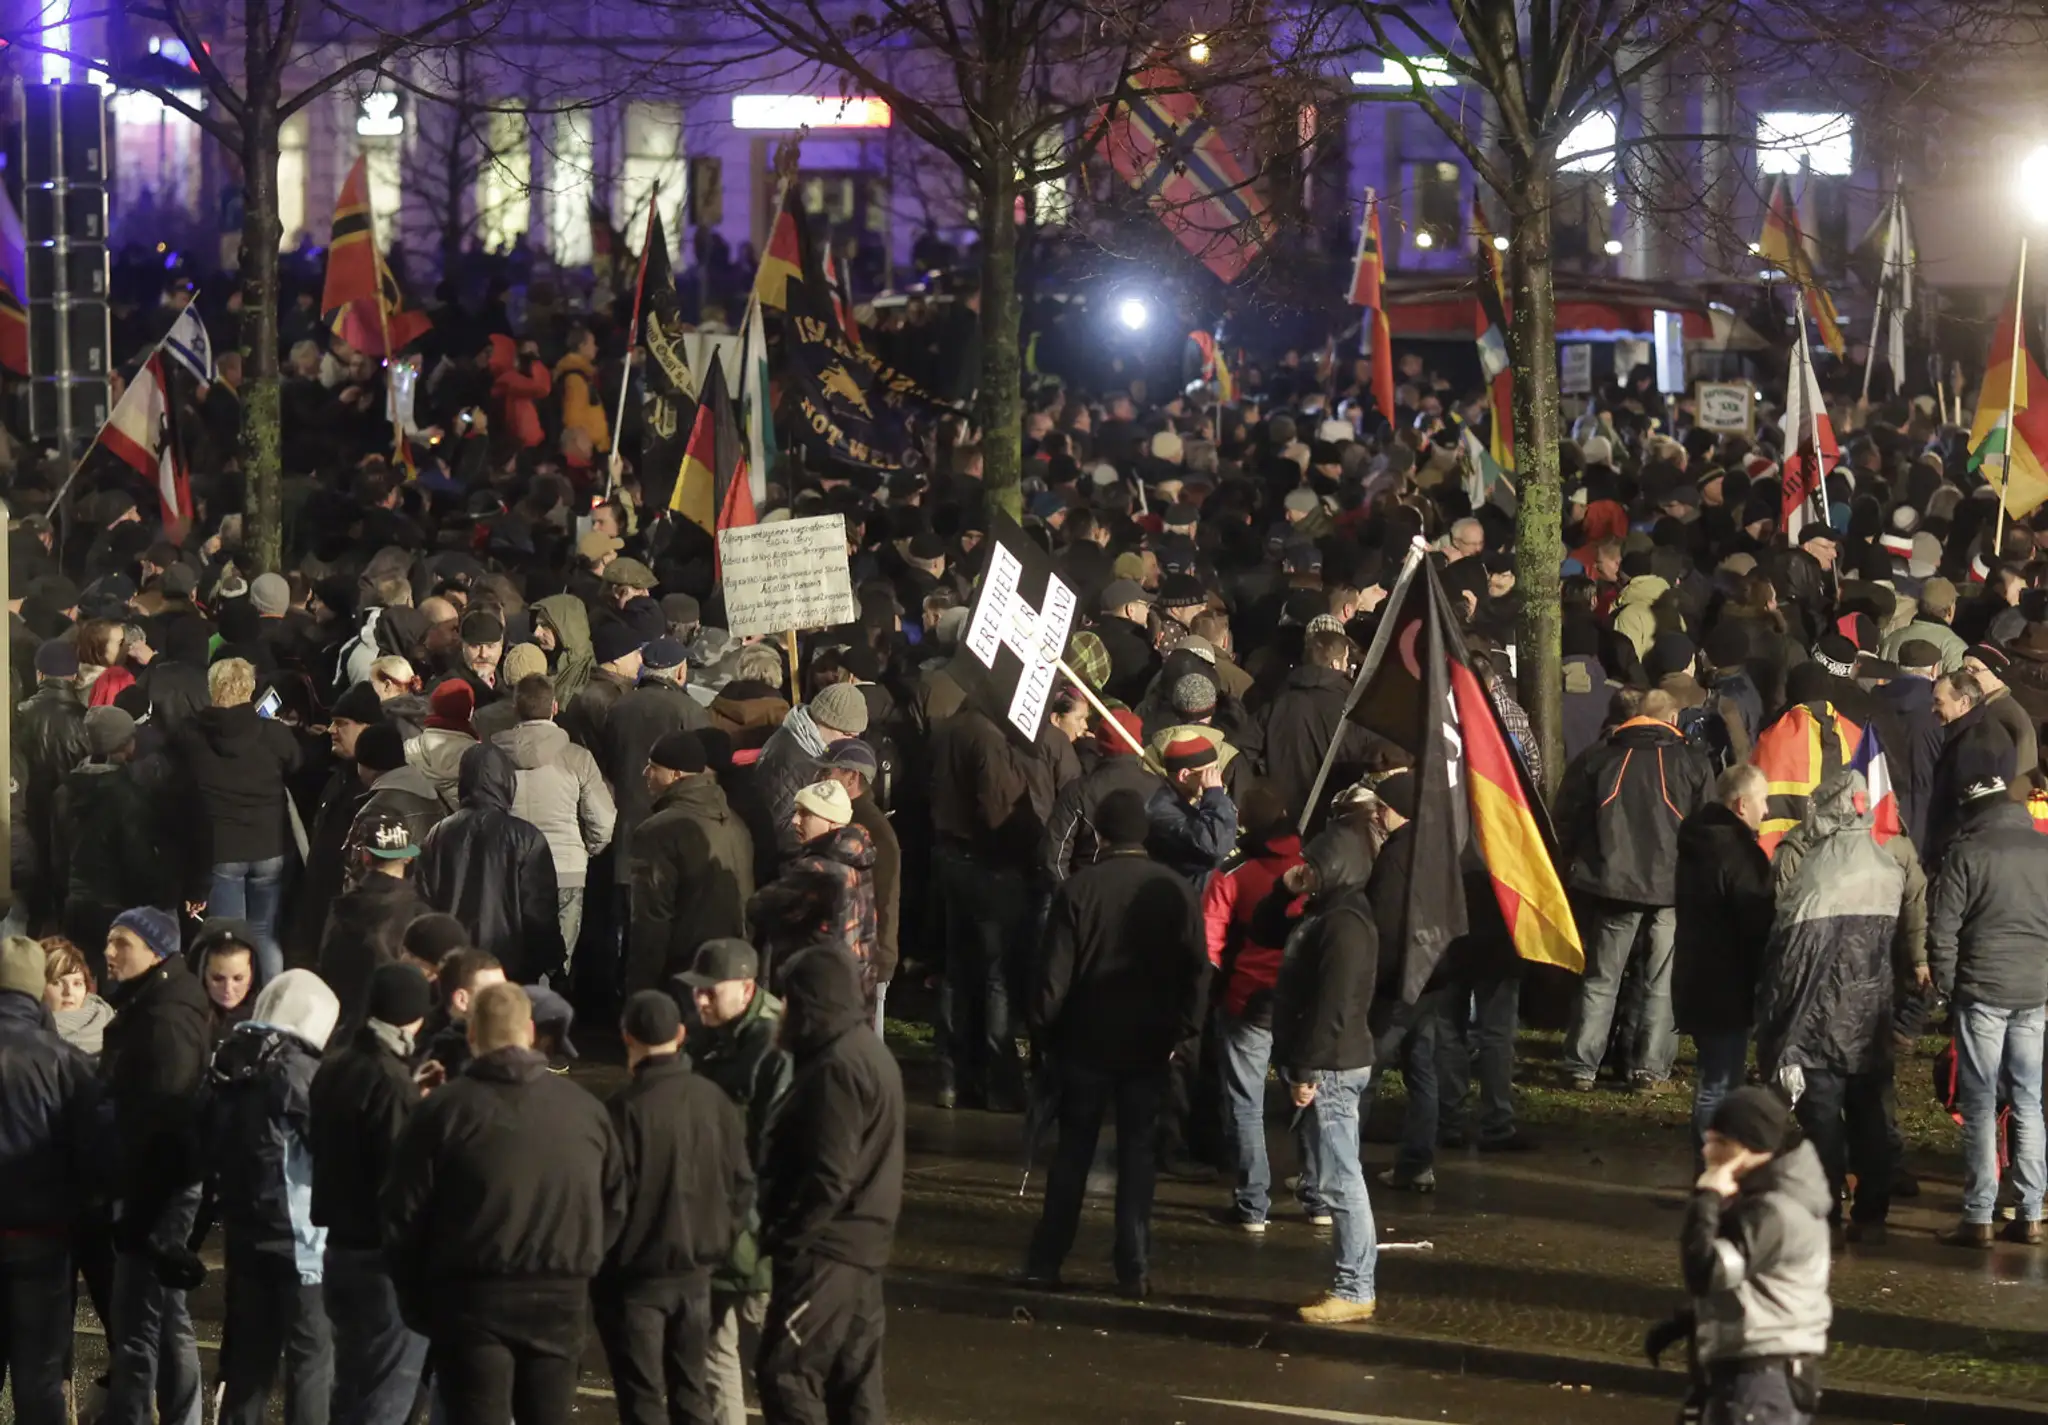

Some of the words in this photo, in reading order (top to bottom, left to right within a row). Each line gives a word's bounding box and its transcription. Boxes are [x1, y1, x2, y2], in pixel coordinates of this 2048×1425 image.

[800, 396, 844, 447] NOT
[975, 551, 1017, 658] FREIHEIT
[1016, 585, 1072, 732] DEUTSCHLAND
